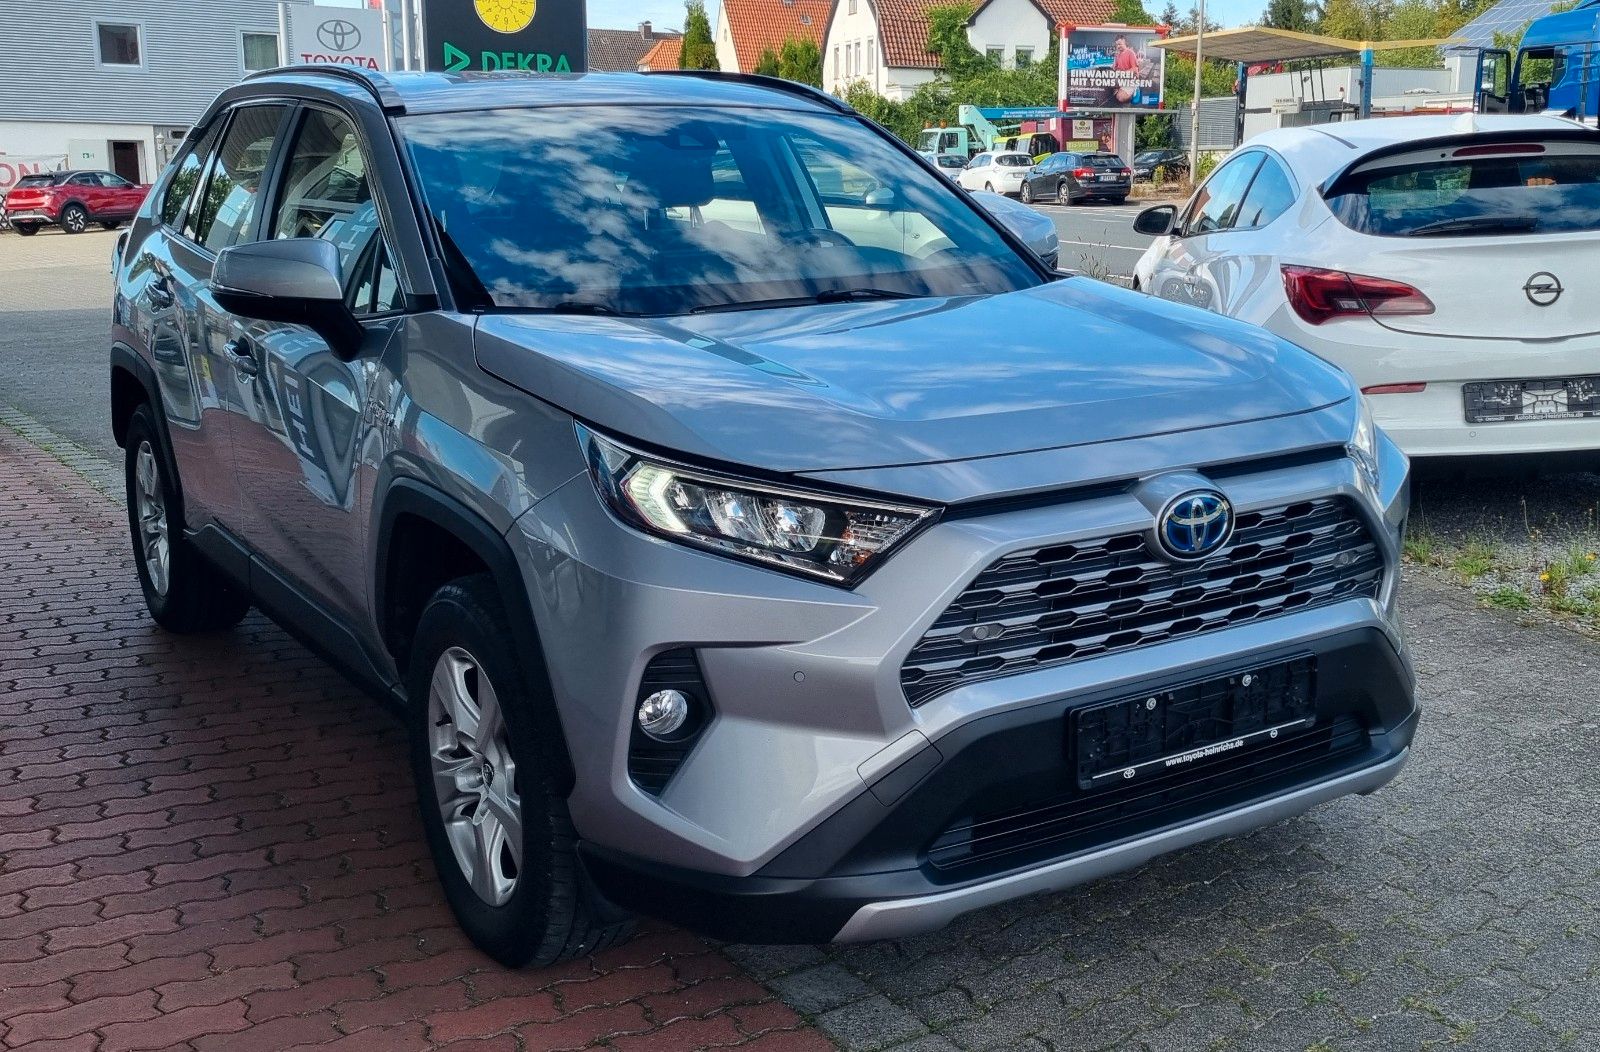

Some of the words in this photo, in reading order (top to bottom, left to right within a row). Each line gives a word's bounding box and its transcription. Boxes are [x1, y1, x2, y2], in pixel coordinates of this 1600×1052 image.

[1073, 47, 1088, 55] WIE
[301, 54, 379, 71] TOYOTA
[481, 51, 571, 72] DEKRA
[1070, 69, 1136, 80] EINWANDFREI,
[1070, 78, 1088, 86] MIT
[1090, 78, 1116, 87] TOMS
[1118, 79, 1152, 88] WISSEN
